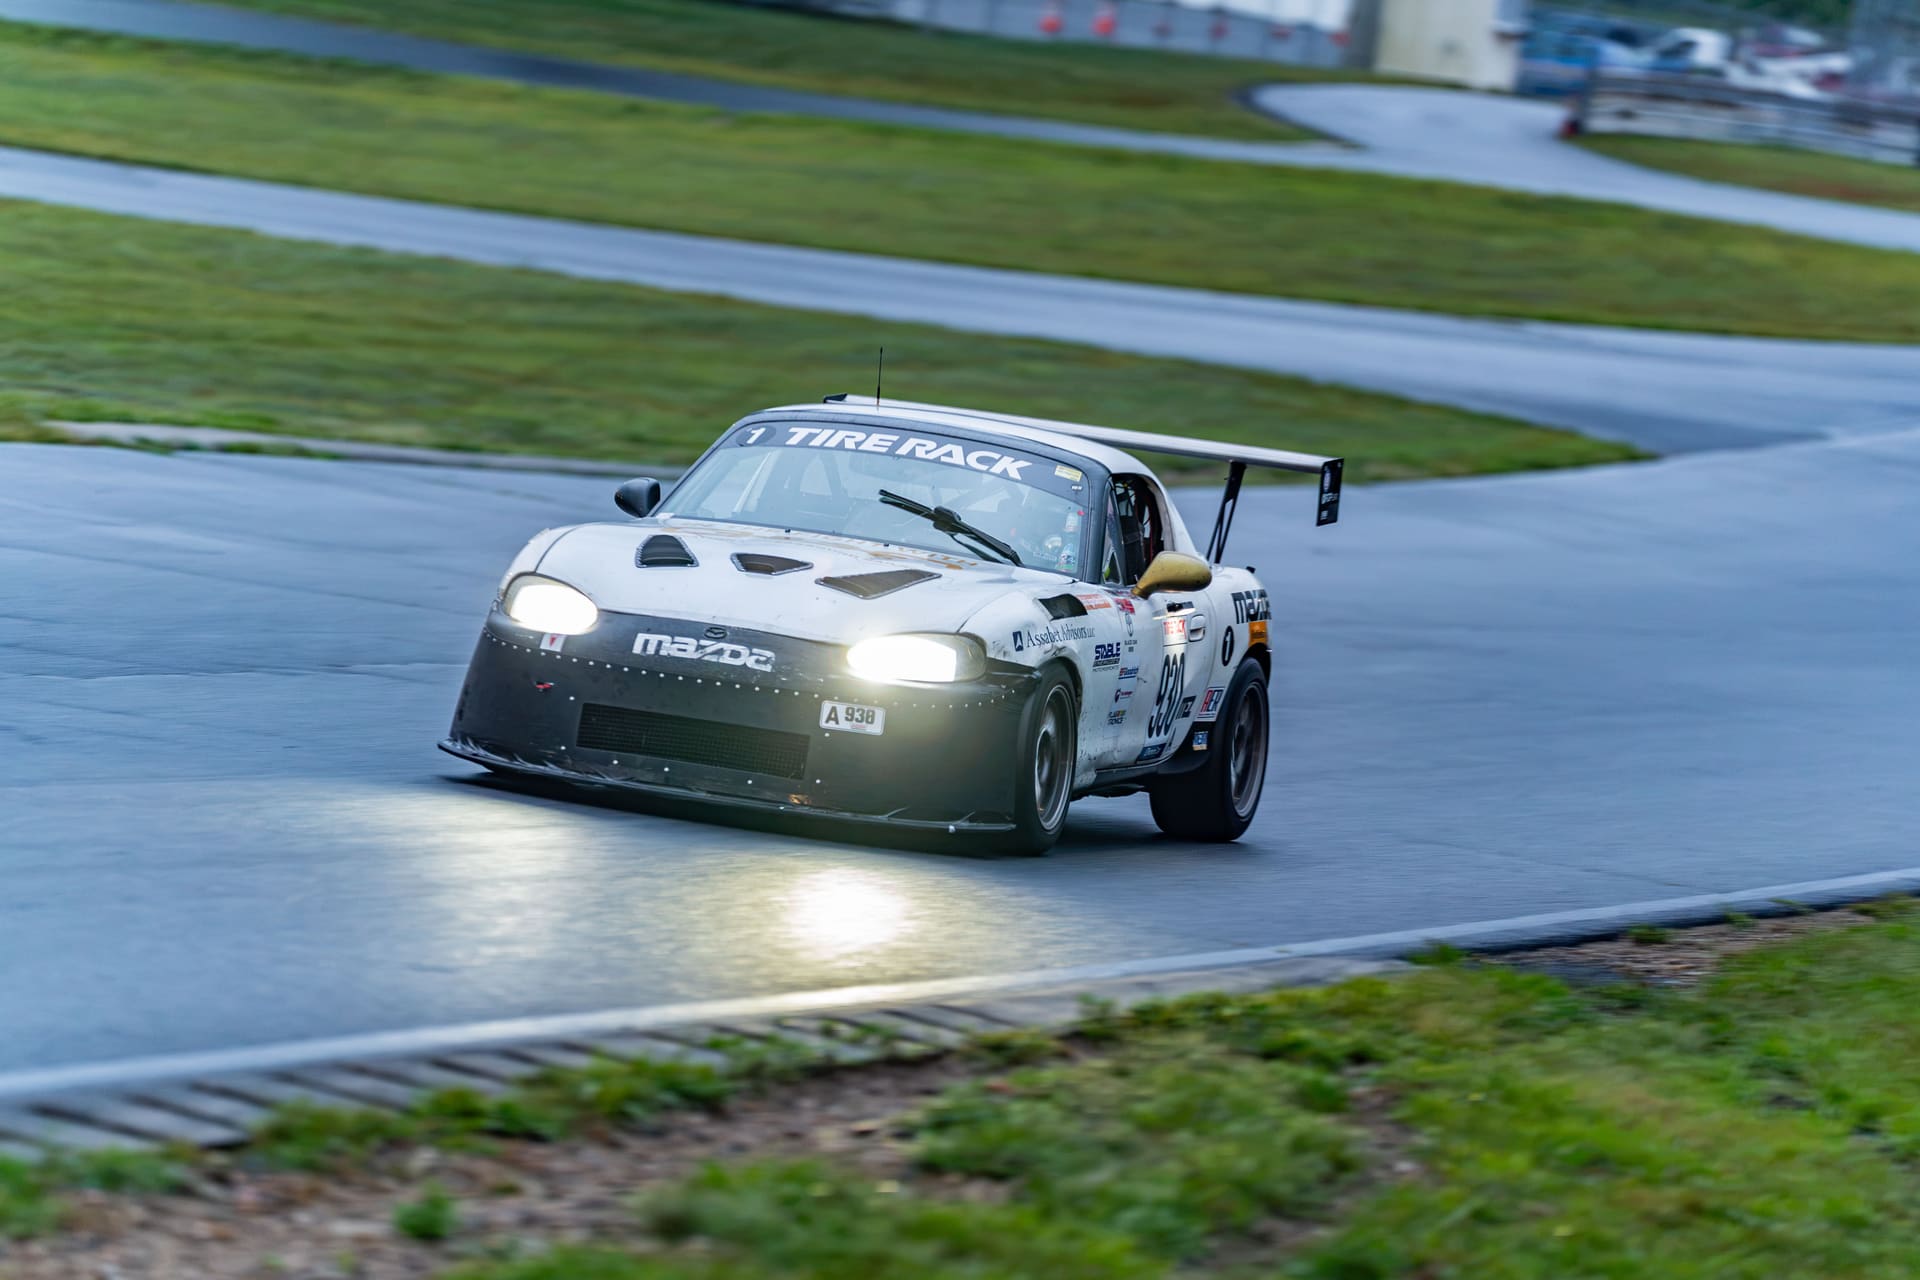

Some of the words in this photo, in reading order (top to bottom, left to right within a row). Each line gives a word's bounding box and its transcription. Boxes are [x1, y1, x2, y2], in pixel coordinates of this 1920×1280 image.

[785, 427, 900, 452] TIRE
[896, 438, 1033, 480] RACK
[825, 705, 840, 725] A
[844, 706, 876, 725] 938
